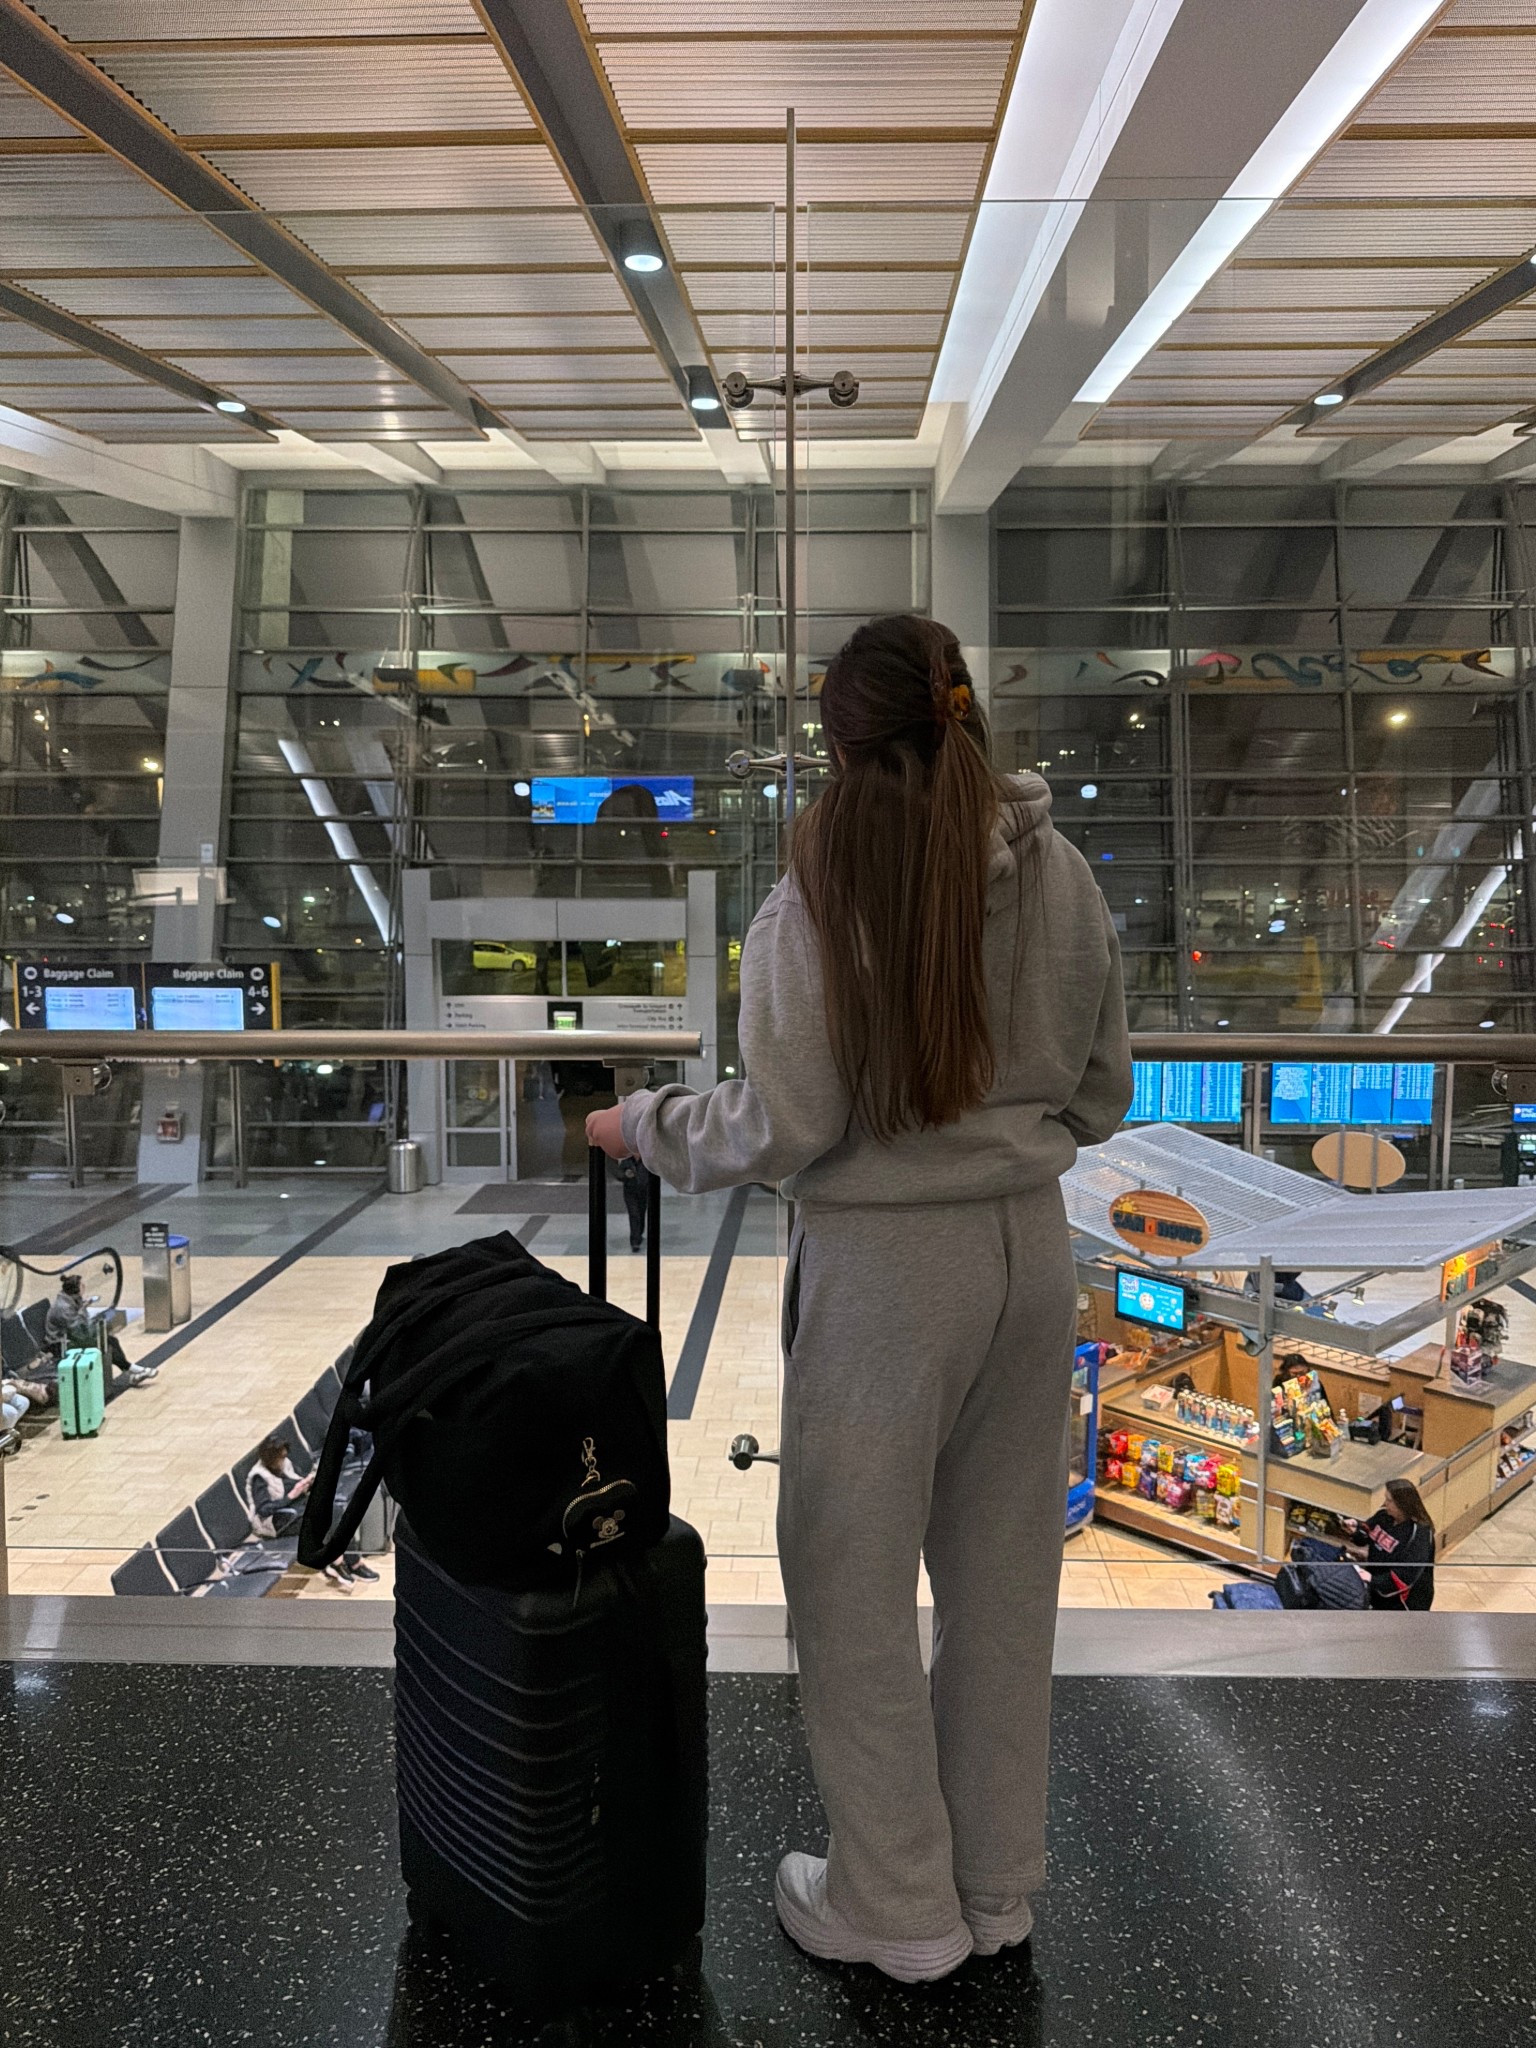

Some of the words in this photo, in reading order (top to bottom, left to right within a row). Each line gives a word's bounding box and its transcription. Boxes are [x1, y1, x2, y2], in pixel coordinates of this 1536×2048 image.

[43, 967, 85, 981] Baggage
[87, 967, 115, 979] Claim
[172, 968, 215, 981] Baggage
[216, 968, 244, 979] Claim
[22, 985, 43, 998] 1-3
[247, 985, 269, 998] 4-6
